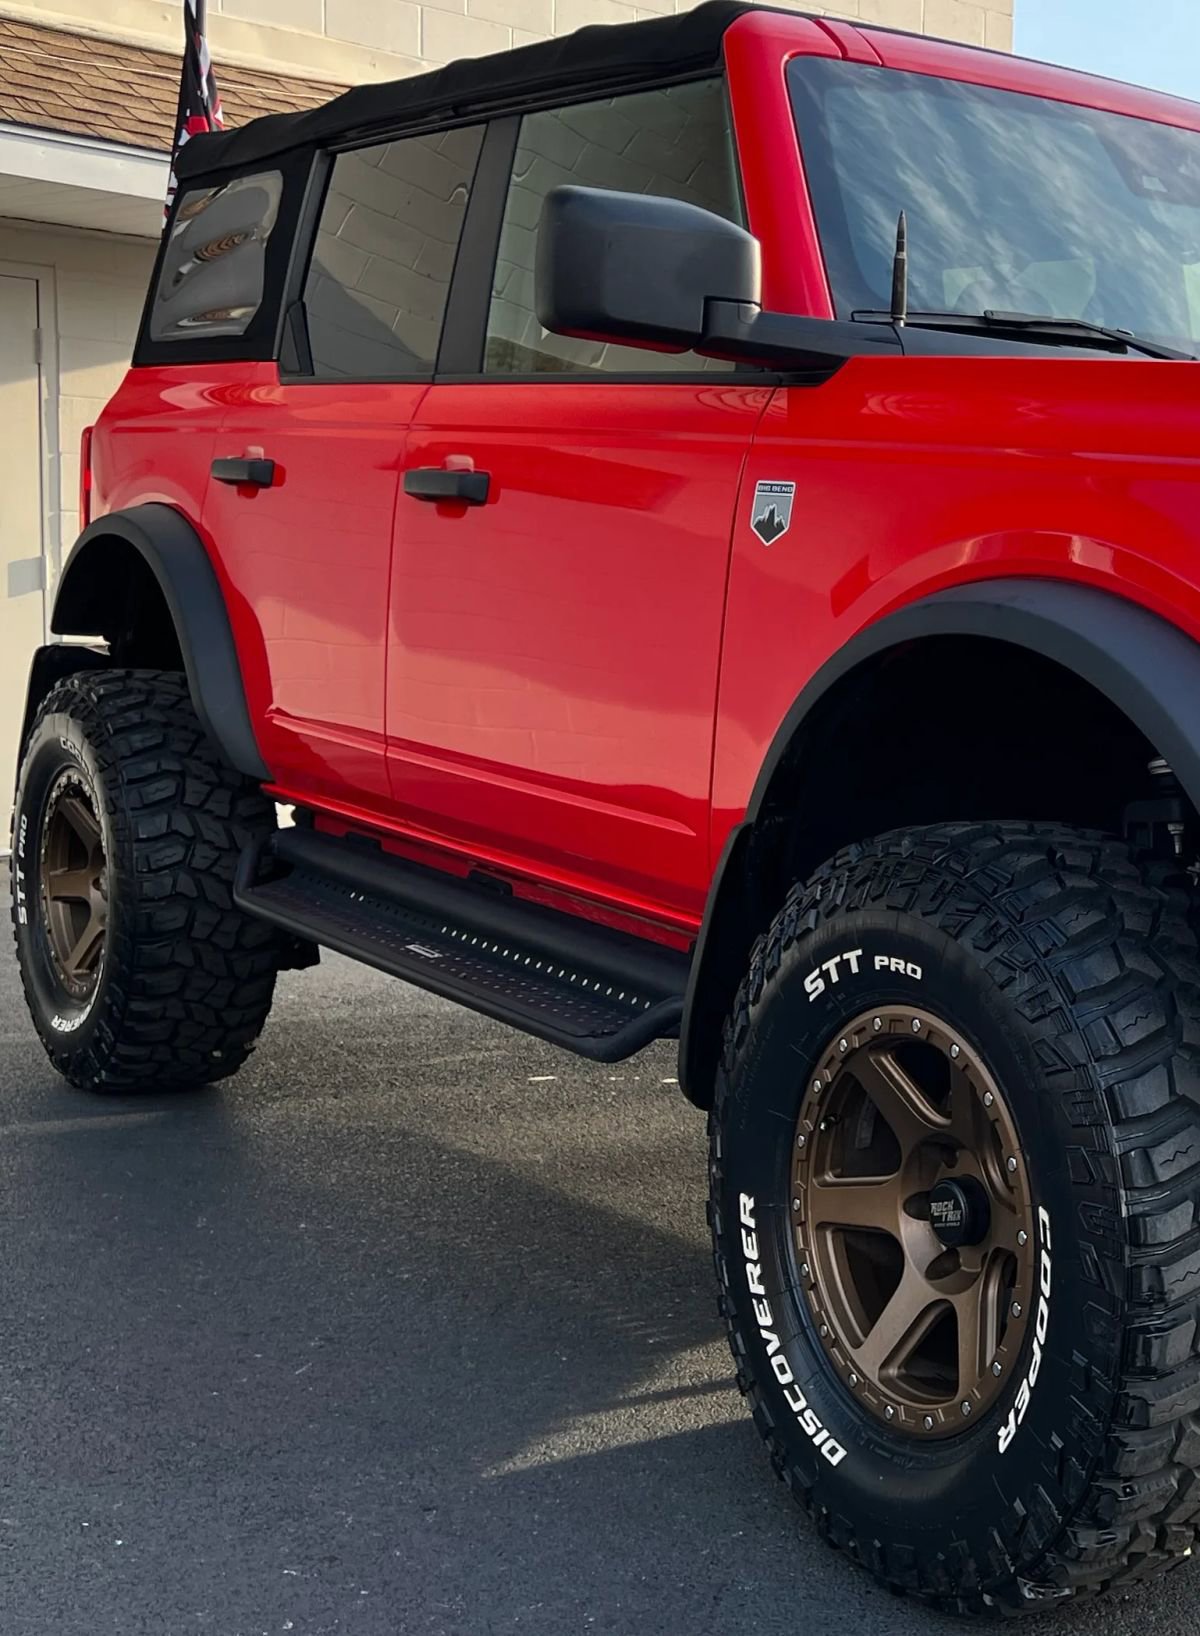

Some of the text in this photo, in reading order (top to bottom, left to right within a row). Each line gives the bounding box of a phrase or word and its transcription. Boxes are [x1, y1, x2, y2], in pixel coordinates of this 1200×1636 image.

[16, 813, 28, 925] STT PRO
[803, 948, 922, 1002] STT PRO
[739, 1192, 848, 1467] DISCOVERER
[997, 1206, 1052, 1454] COOPER
